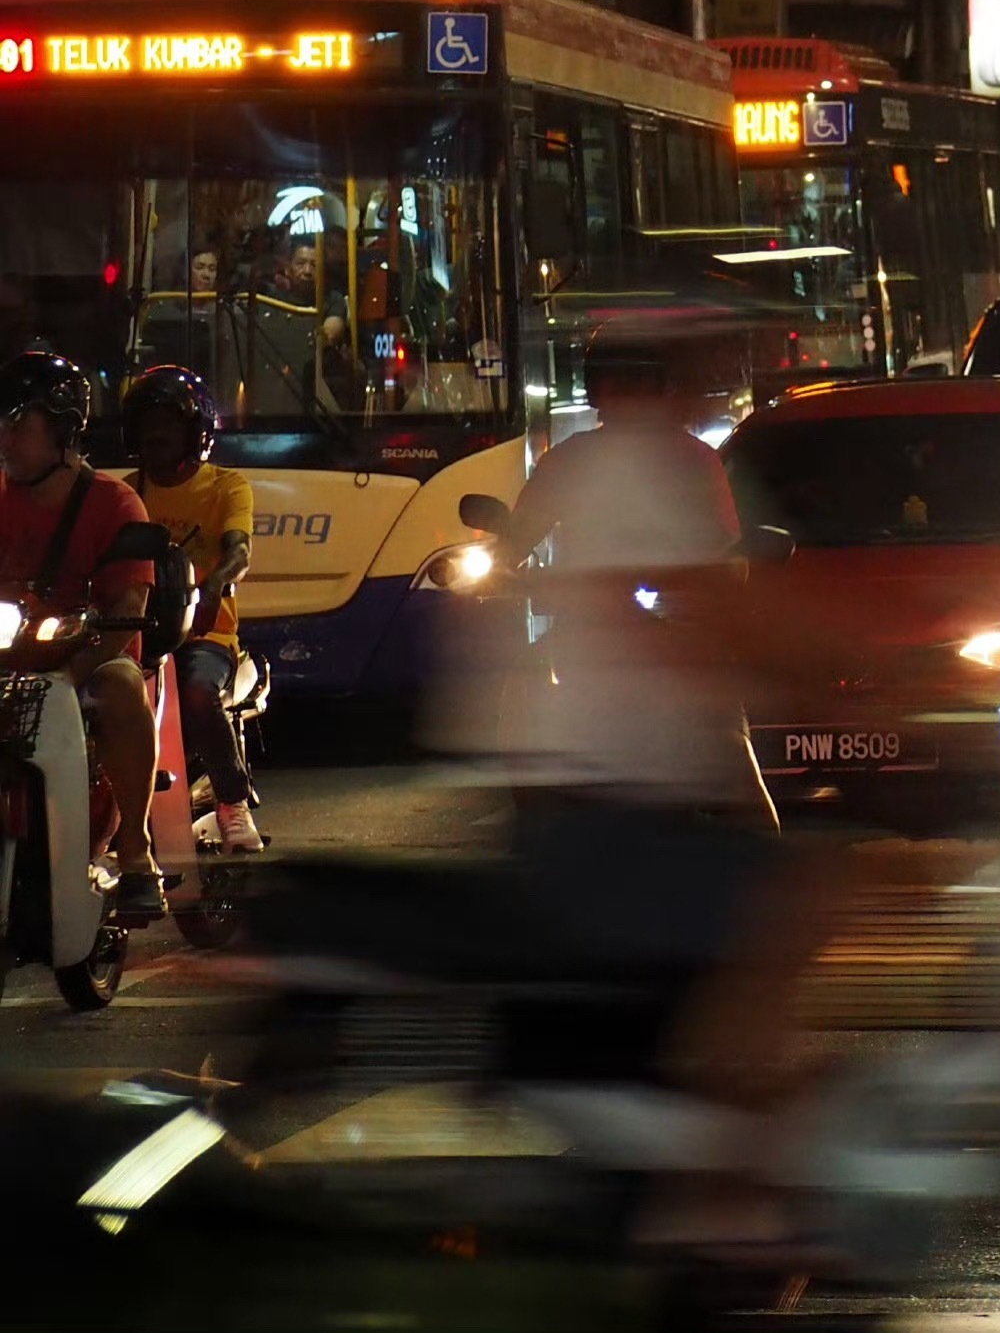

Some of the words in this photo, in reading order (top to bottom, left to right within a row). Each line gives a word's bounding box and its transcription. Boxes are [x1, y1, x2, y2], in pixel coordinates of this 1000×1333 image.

[0, 38, 33, 72] 01
[48, 37, 131, 71] TELUK
[143, 36, 243, 71] KUMBAR
[289, 34, 352, 69] JETI
[381, 448, 439, 459] SCANIA
[253, 513, 331, 544] ang
[785, 733, 833, 761] PNW
[838, 732, 900, 760] 8509
